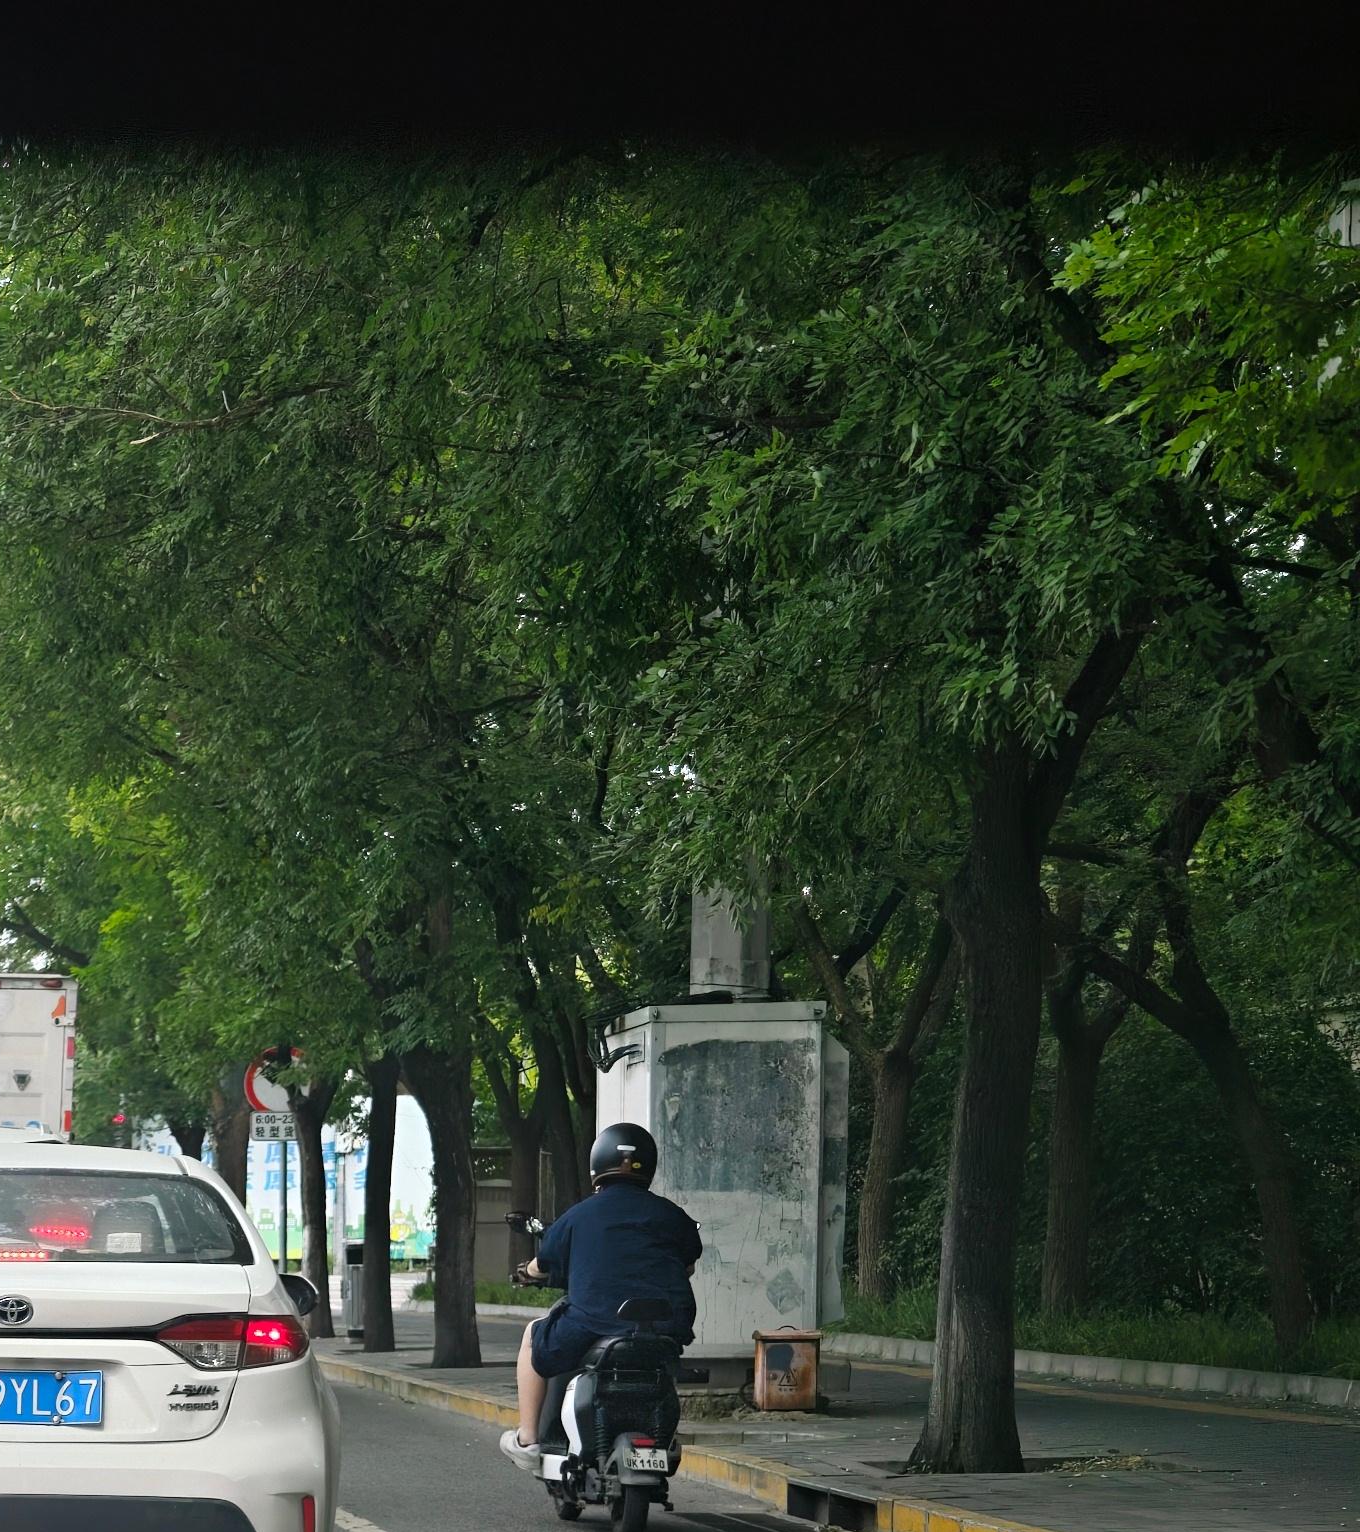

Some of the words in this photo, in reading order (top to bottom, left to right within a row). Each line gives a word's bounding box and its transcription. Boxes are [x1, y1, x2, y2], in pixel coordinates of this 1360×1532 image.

[256, 1114, 294, 1124] 6:00-23
[256, 1126, 294, 1137] 轻型货
